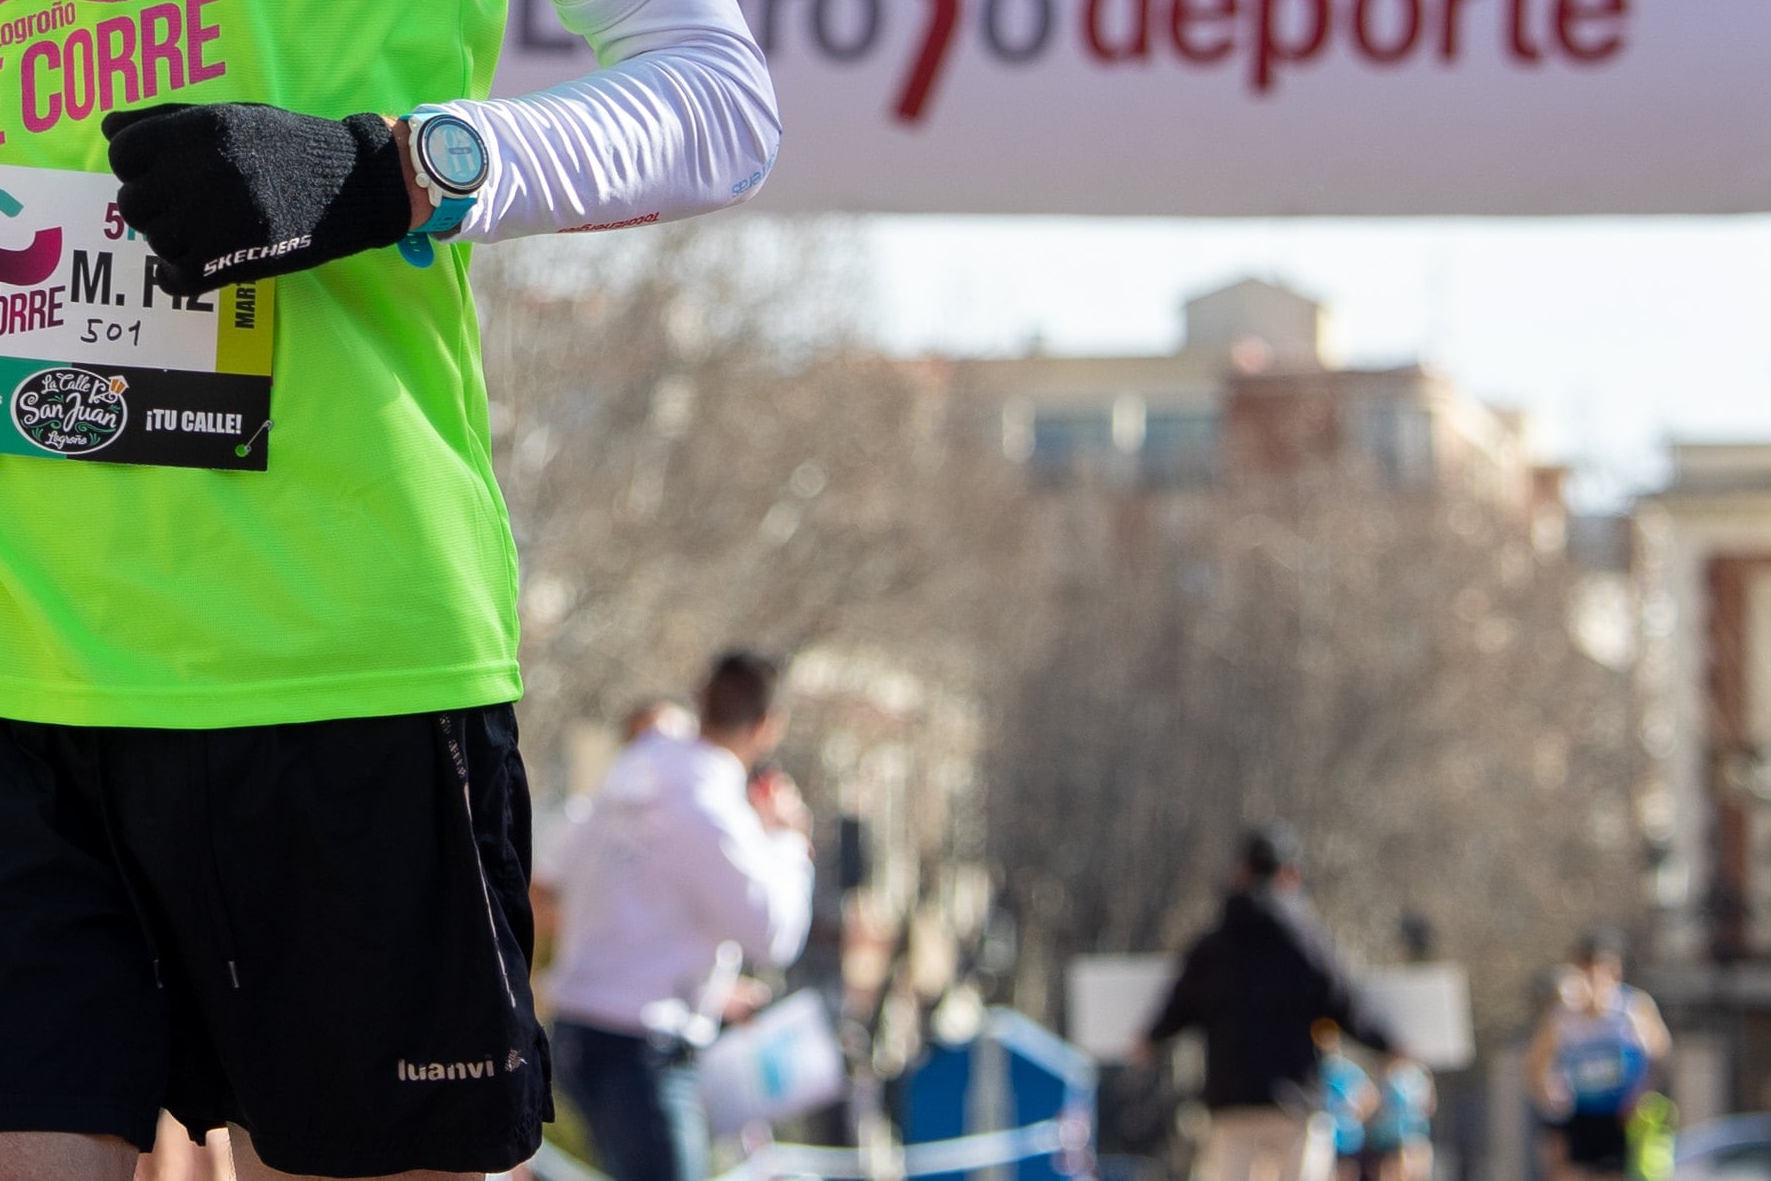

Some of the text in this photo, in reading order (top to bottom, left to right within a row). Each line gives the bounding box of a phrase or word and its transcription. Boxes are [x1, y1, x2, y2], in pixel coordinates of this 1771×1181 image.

[103, 202, 147, 242] 5
[202, 233, 313, 278] SKECHERS
[70, 249, 125, 307] M.
[80, 318, 142, 347] 501
[41, 372, 91, 394] La Calle
[19, 391, 117, 432] San Juan
[145, 408, 242, 435] ¡TU CALLE!
[398, 1054, 495, 1082] luanvi
